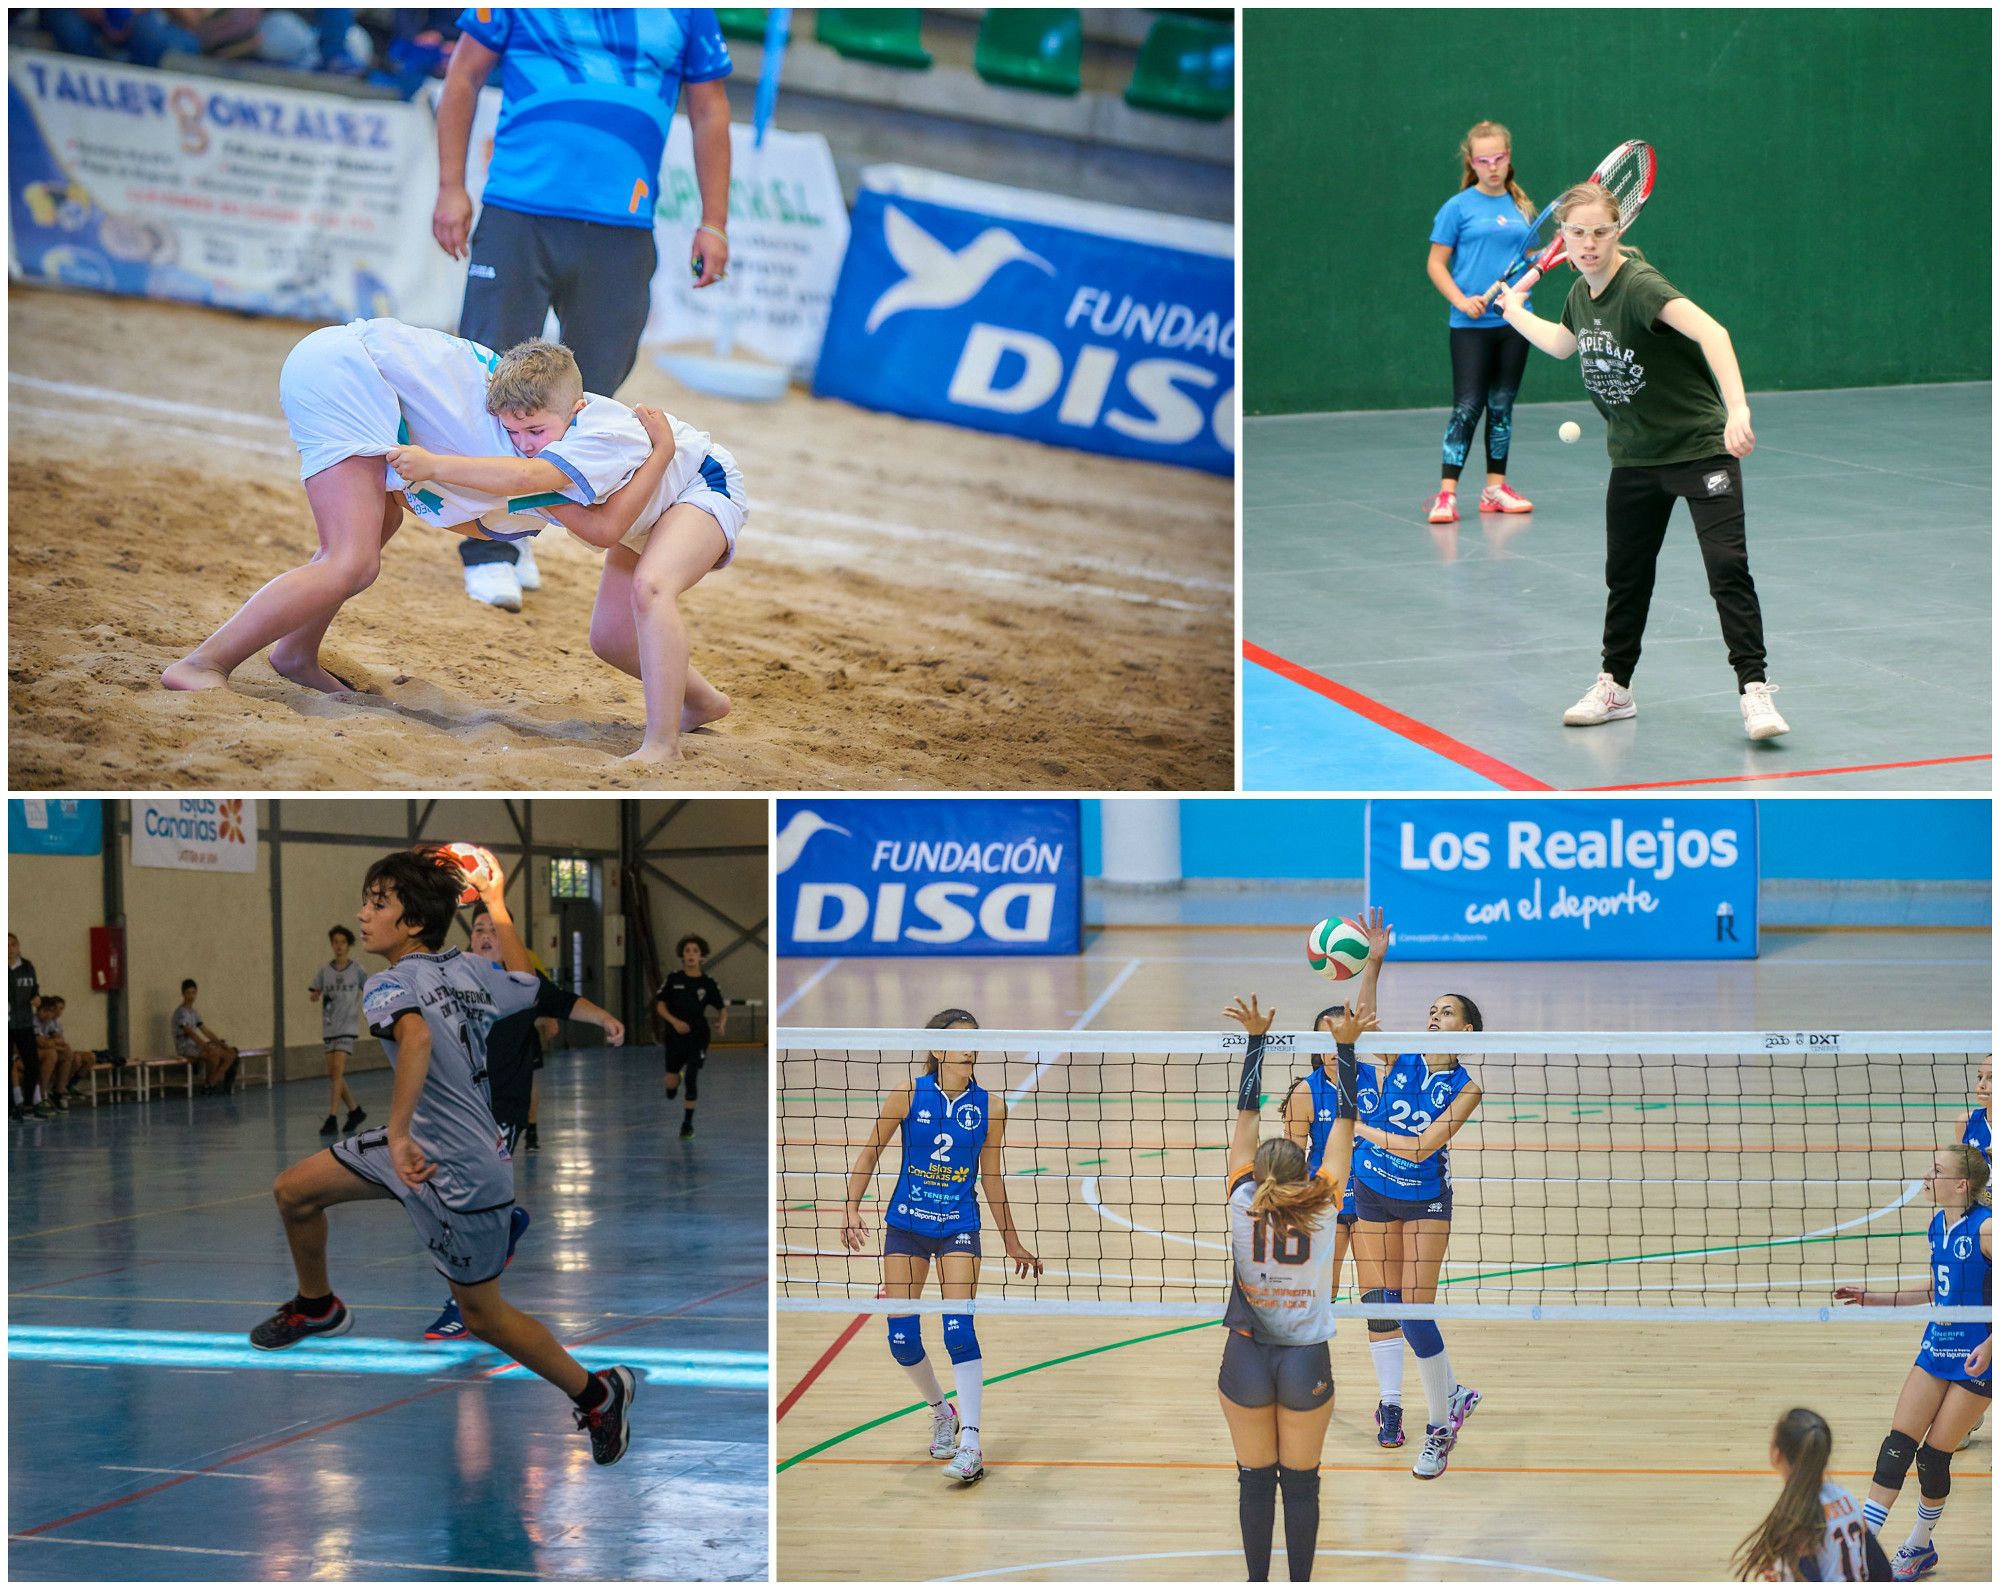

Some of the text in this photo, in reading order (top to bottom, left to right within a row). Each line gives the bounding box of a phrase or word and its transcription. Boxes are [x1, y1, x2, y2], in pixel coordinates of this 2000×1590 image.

[1605, 341, 1635, 363] BAR
[144, 808, 218, 842] Canarias
[871, 836, 1063, 874] FUNDACIÓN
[1400, 818, 1739, 881] Los Realejos
[1465, 877, 1660, 930] con el deporte
[1809, 1034, 1840, 1045] DXT
[1388, 1099, 1432, 1137] 22
[930, 1132, 954, 1162] 2
[908, 1164, 951, 1182] Canarias
[928, 1162, 953, 1174] Islas
[923, 1191, 960, 1201] TENERIFE
[1937, 1264, 1951, 1297] 5
